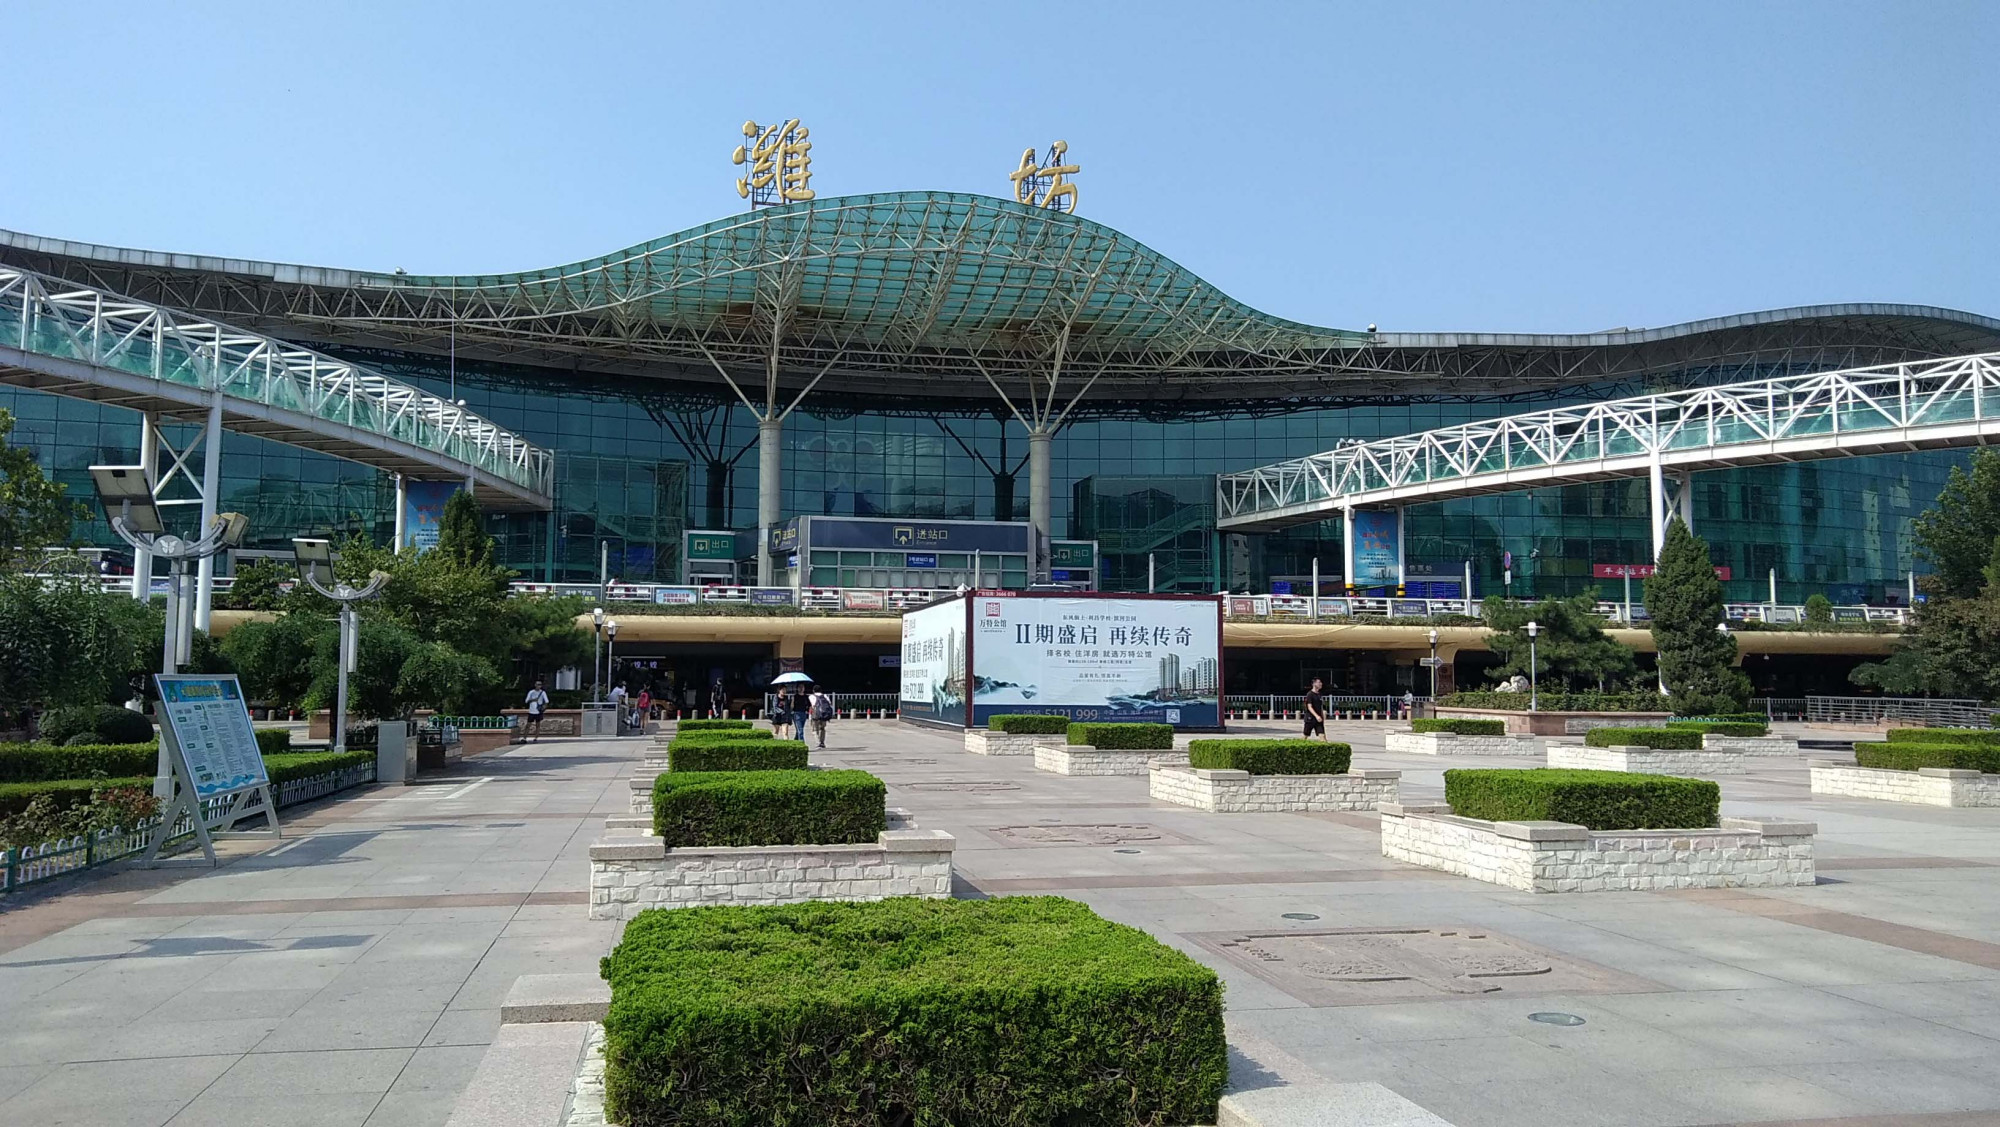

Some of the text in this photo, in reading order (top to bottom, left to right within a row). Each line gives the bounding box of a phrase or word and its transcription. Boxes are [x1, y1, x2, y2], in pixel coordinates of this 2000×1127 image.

[731, 117, 1081, 214] 潍 坊
[916, 528, 948, 540] 进站口
[711, 539, 729, 549] 出口
[1073, 548, 1089, 557] 出口
[980, 619, 1007, 628] 万特公馆
[1108, 625, 1193, 647] 再续传奇
[1046, 649, 1153, 659] 择名校 住洋房 就选万特公馆
[1045, 708, 1072, 720] 5121
[1075, 708, 1098, 721] 999
